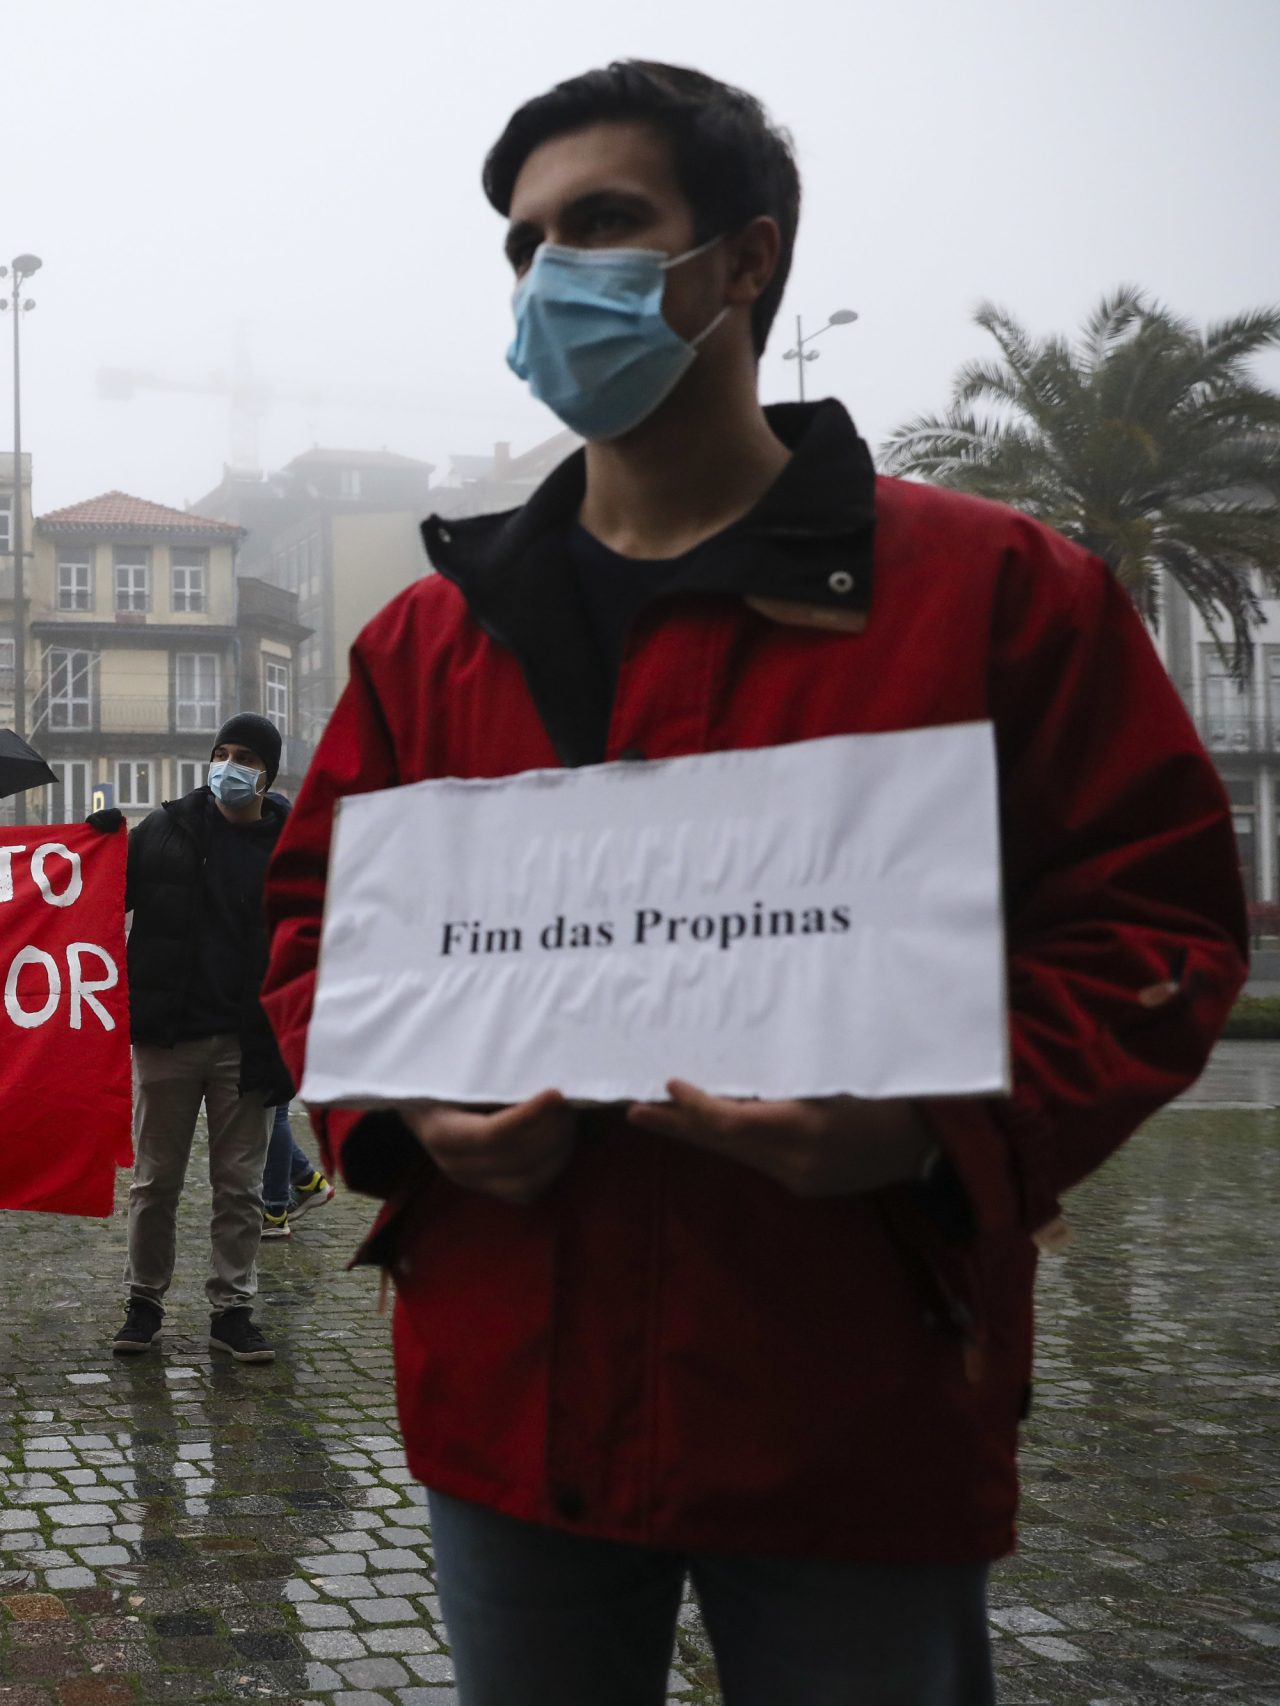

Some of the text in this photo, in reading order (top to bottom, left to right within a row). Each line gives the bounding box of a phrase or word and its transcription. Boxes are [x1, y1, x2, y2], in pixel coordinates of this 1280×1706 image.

[439, 901, 852, 957] Fim das Propinas
